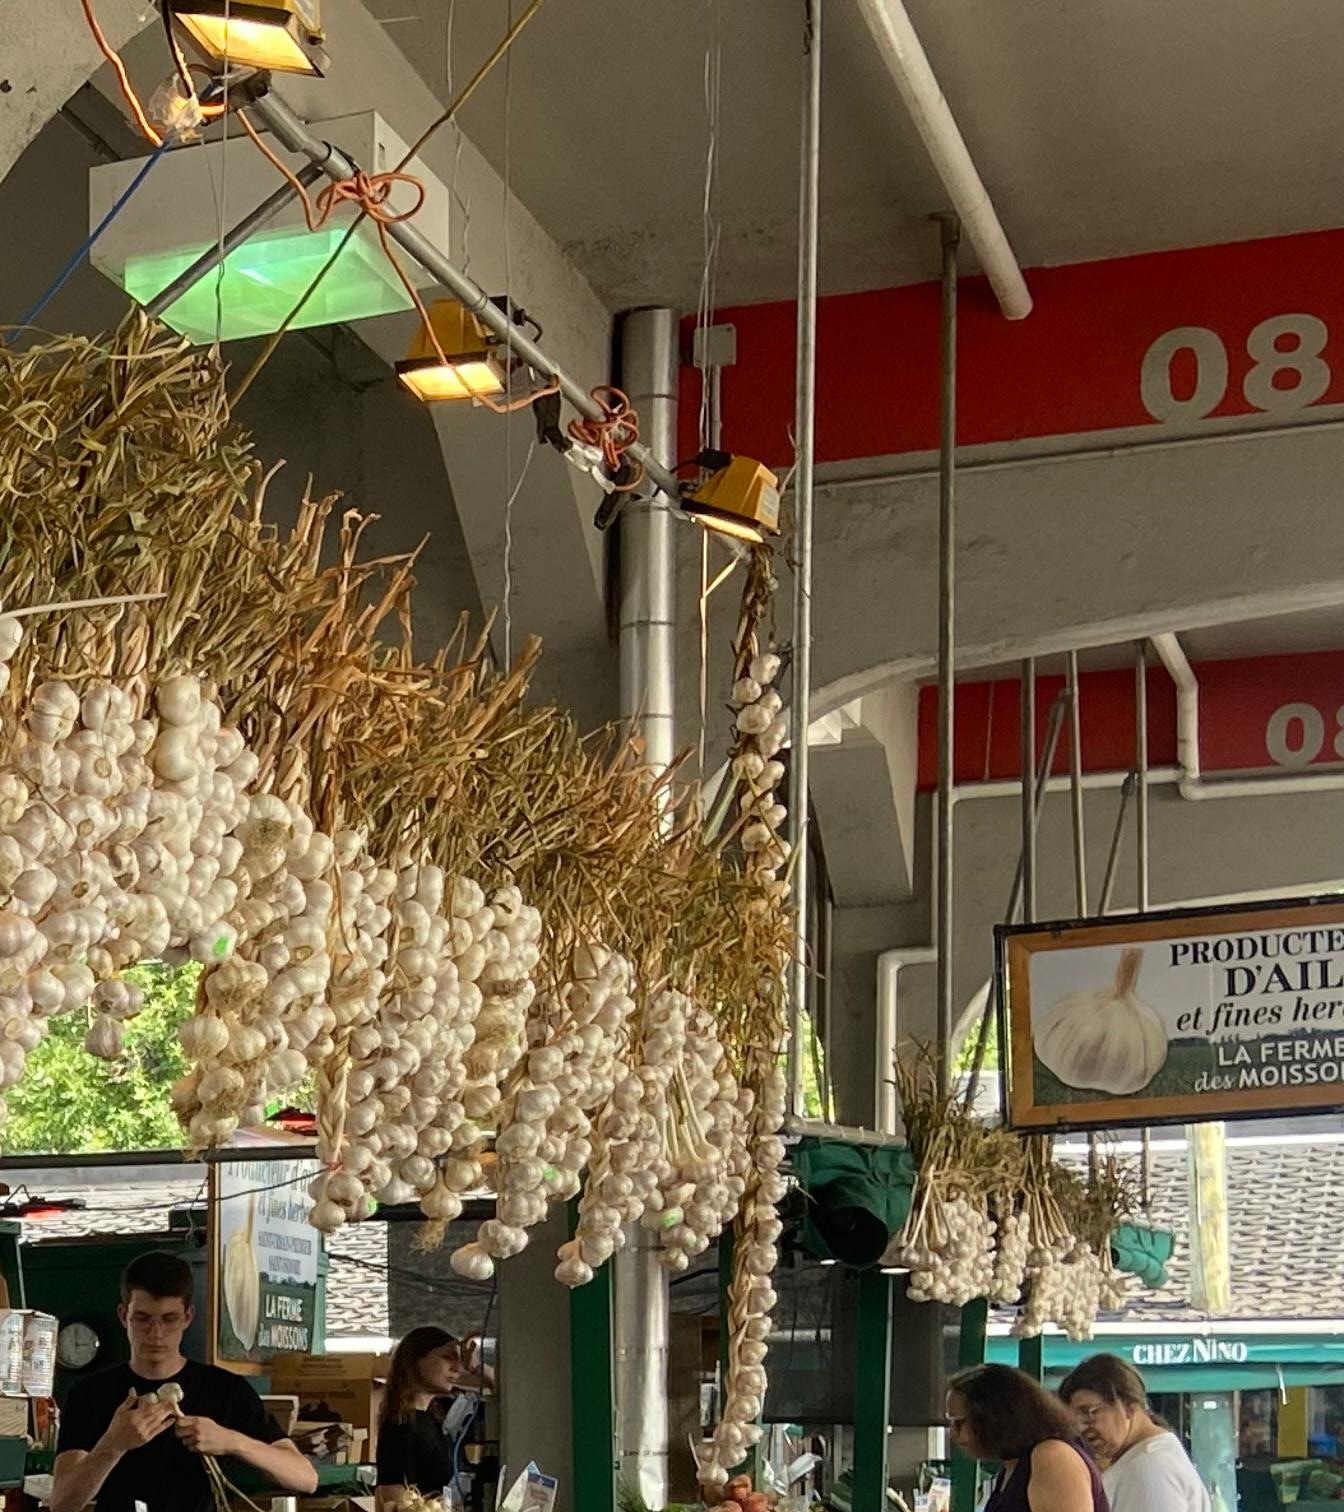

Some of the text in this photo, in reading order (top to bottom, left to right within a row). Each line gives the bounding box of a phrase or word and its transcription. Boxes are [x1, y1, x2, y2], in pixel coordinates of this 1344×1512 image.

[1140, 313, 1331, 424] 08
[1265, 703, 1344, 766] 0
[1224, 958, 1344, 998] D'AIL
[1176, 996, 1344, 1036] et fines her
[1218, 1038, 1344, 1067] LA FERME
[1194, 1061, 1344, 1093] des MOISSO
[265, 1293, 303, 1323] LA FERME
[270, 1324, 309, 1351] MOISSONS
[1132, 1343, 1191, 1365] CHEZ
